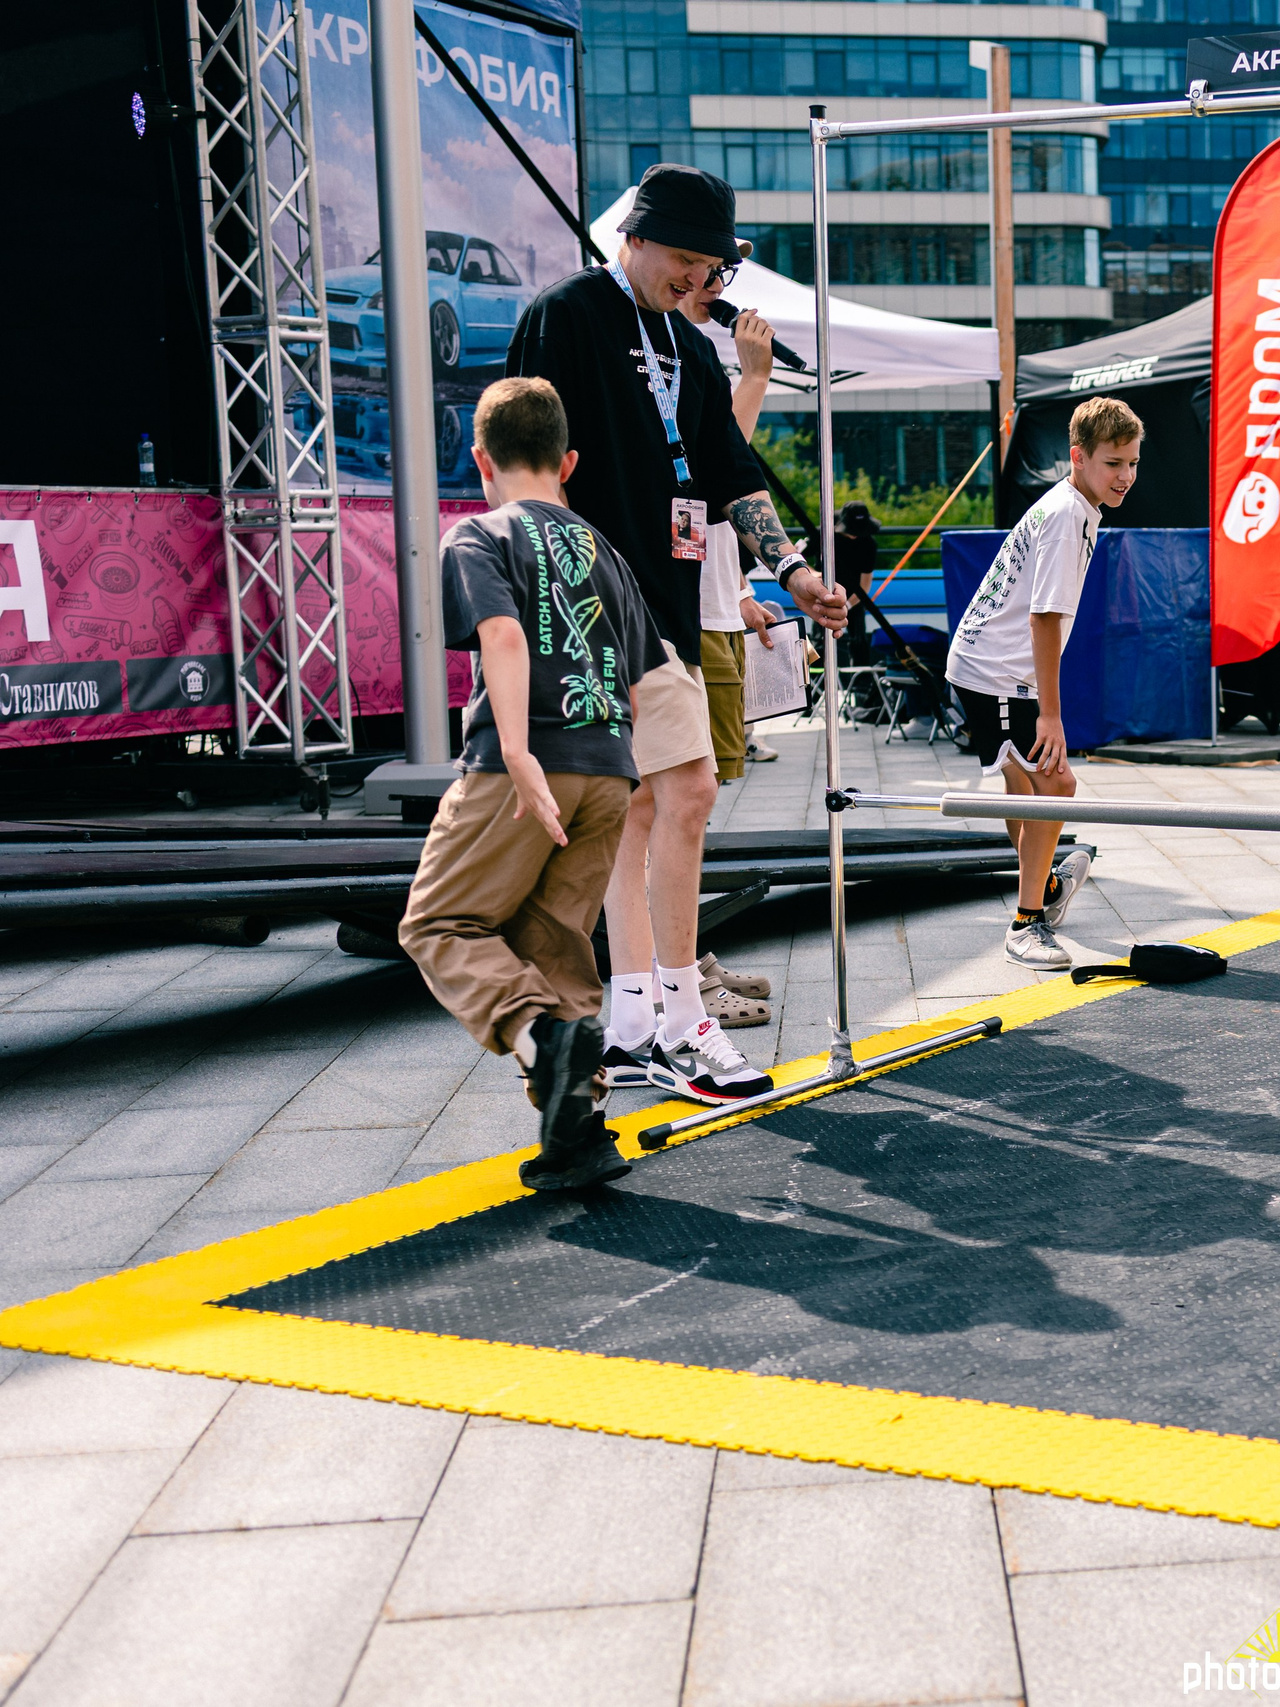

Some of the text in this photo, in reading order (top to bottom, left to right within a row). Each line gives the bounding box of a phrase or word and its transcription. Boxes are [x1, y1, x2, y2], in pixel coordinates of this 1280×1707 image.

[266, 0, 561, 118] АКРФОБИЯ
[520, 514, 553, 655] CATCH YOUR WAVE
[602, 646, 615, 678] FUN
[603, 679, 624, 721] HAVE
